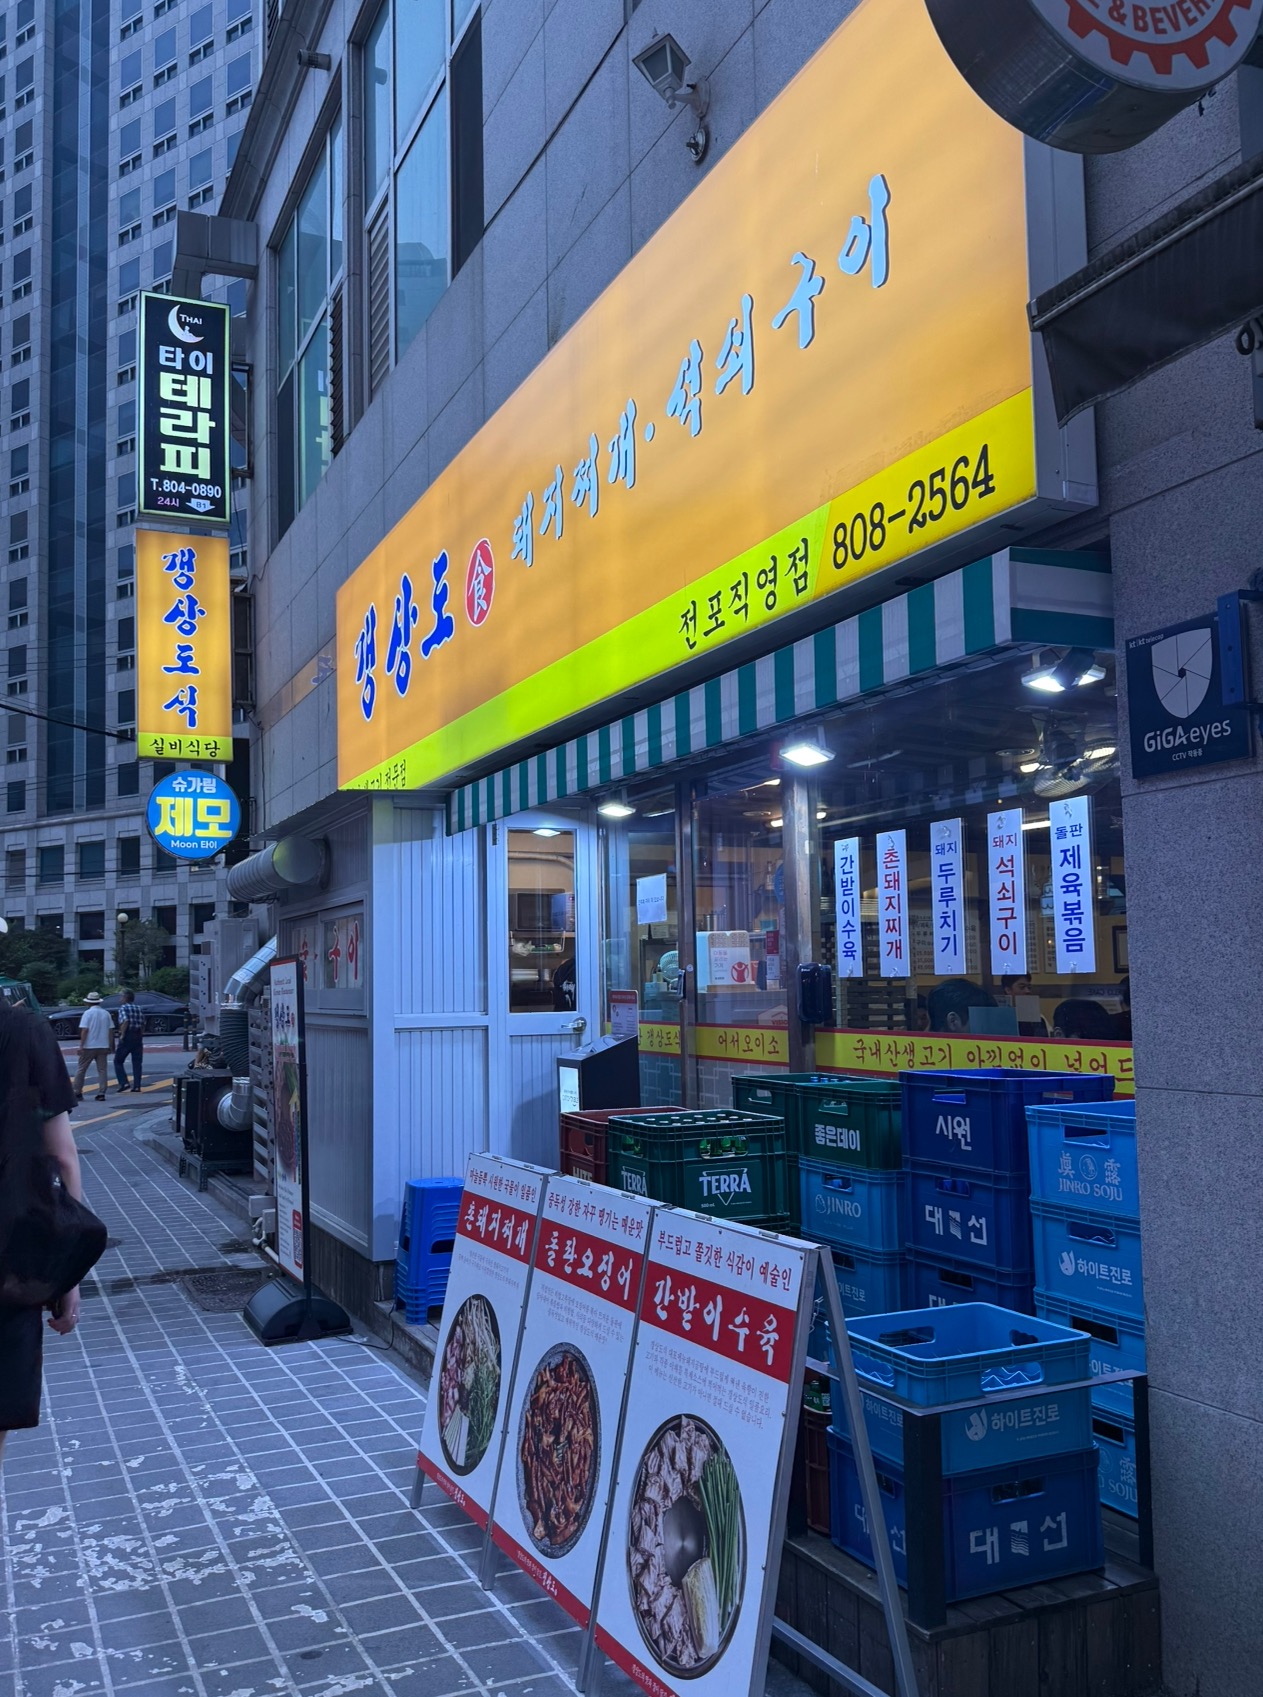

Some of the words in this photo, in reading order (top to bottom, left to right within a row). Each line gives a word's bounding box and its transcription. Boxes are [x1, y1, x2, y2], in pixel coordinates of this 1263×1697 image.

[180, 314, 202, 325] THAI
[159, 345, 213, 375] 타이
[159, 372, 216, 480] 테라피
[151, 478, 221, 498] T.804-0890
[157, 496, 179, 507] 24시
[832, 443, 996, 570] 808-2564
[149, 737, 220, 758] 실비식당
[1172, 752, 1186, 760] CCTV
[172, 776, 216, 794] 슈가링
[154, 797, 232, 838] 제모
[171, 839, 198, 850] Moon
[992, 832, 1018, 848] 돼지
[1054, 823, 1083, 840] 돌판
[935, 841, 957, 856] 돼지
[840, 855, 857, 960] 간받이수육
[883, 848, 903, 959] 촌돼지찌개
[937, 862, 957, 956] 두루치기
[995, 855, 1018, 955] 석쇠구이
[1059, 844, 1086, 953] 제육볶음
[718, 1031, 780, 1055] 어서오이소
[814, 1123, 861, 1151] 좋은데이
[936, 1115, 972, 1151] 시원
[621, 1171, 648, 1197] TERRA
[699, 1173, 752, 1196] TERRA
[1058, 1178, 1090, 1195] JINRO
[1094, 1184, 1123, 1201] SOJU
[566, 1196, 582, 1218] 강한
[581, 1201, 596, 1223] 자꾸
[620, 1213, 644, 1240] 매운맛
[826, 1197, 861, 1218] JINRO
[656, 1228, 692, 1259] 부드럽고
[693, 1239, 723, 1269] 쫄깃한
[724, 1248, 755, 1280] 식감이
[758, 1258, 792, 1292] 예술인
[1077, 1258, 1133, 1285] 하이트진로
[991, 1403, 1060, 1432] 하이트진로
